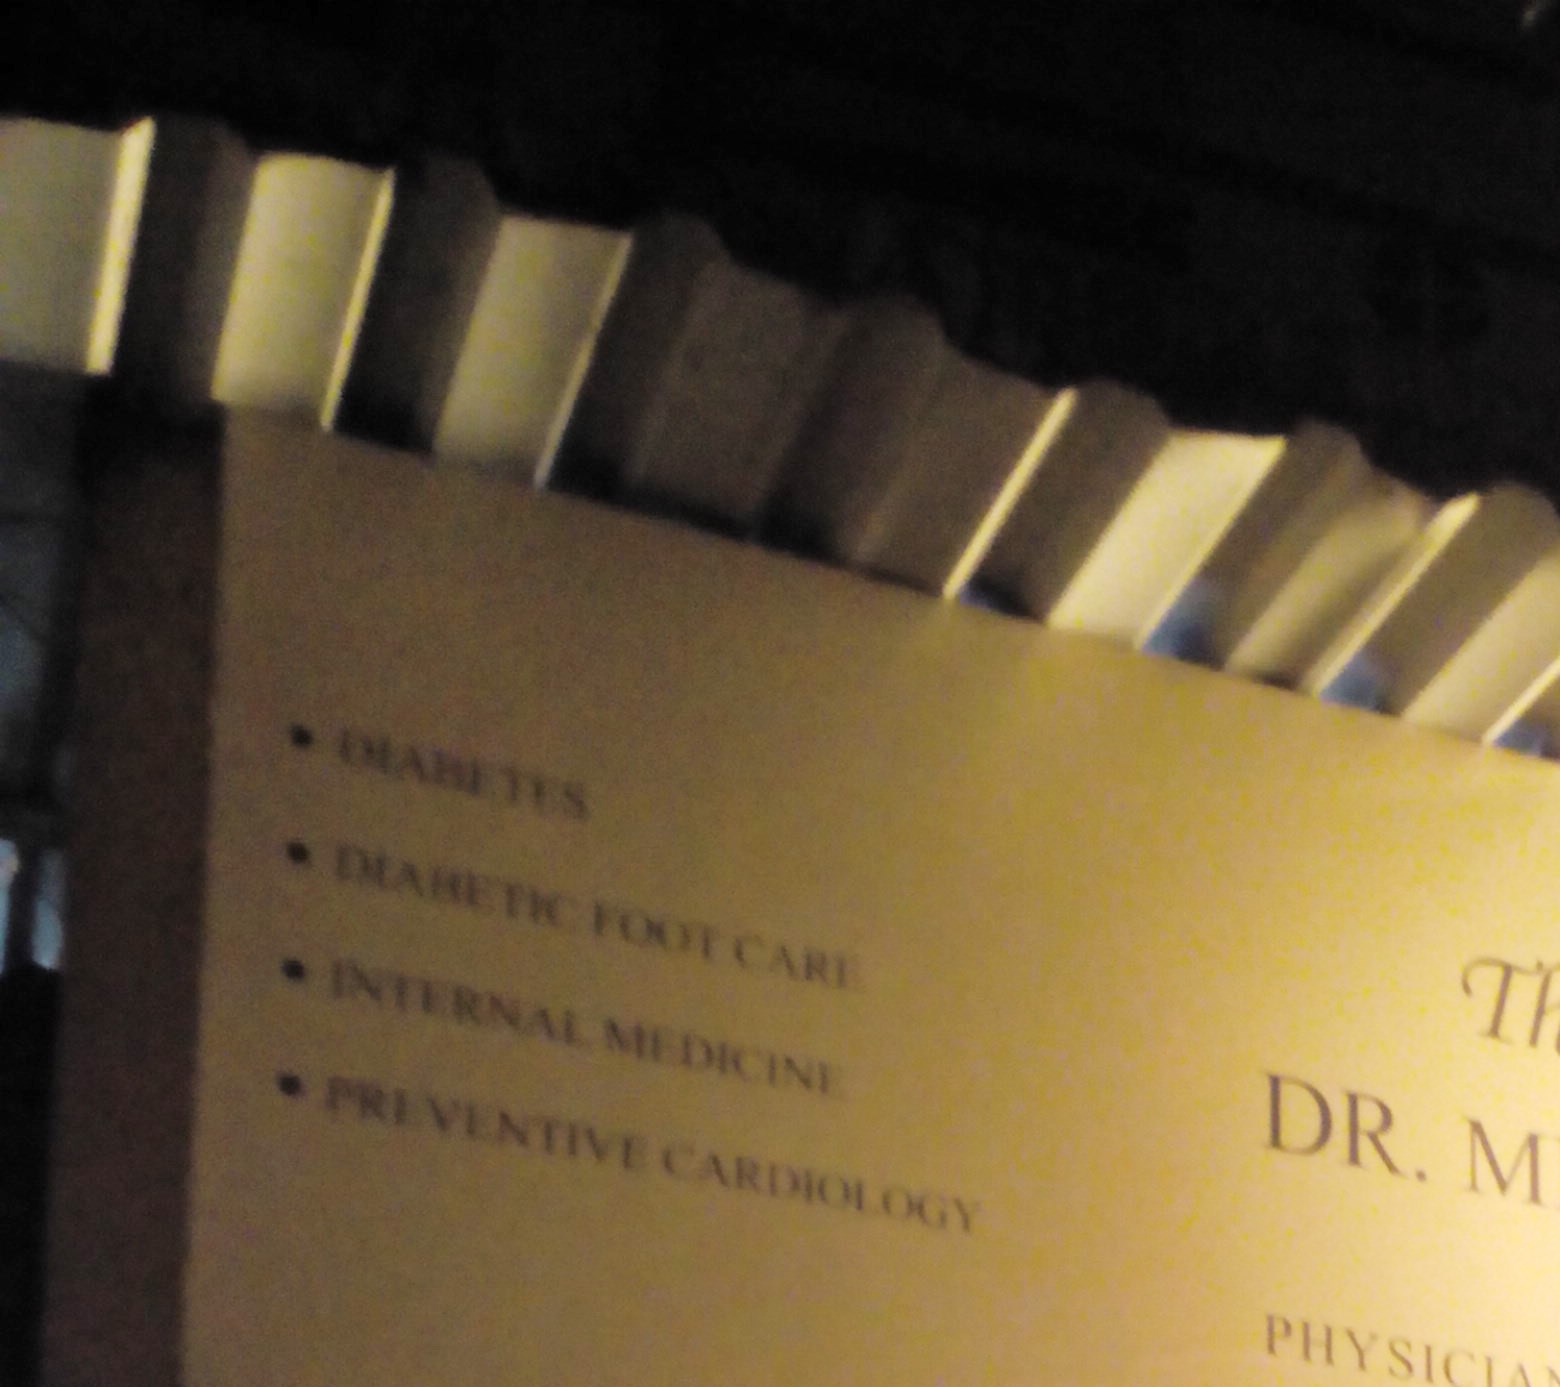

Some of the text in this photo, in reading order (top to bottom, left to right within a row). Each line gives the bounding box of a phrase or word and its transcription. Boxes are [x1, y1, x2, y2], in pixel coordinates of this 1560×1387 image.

[332, 726, 590, 821] DIABETES
[332, 843, 860, 992] DIABETIC FOOT CARE
[330, 959, 846, 1098] INTERNAL MEDICINE
[324, 1076, 981, 1236] PREVENTIVE CARDIOLOGY
[1262, 1071, 1428, 1183] DR.
